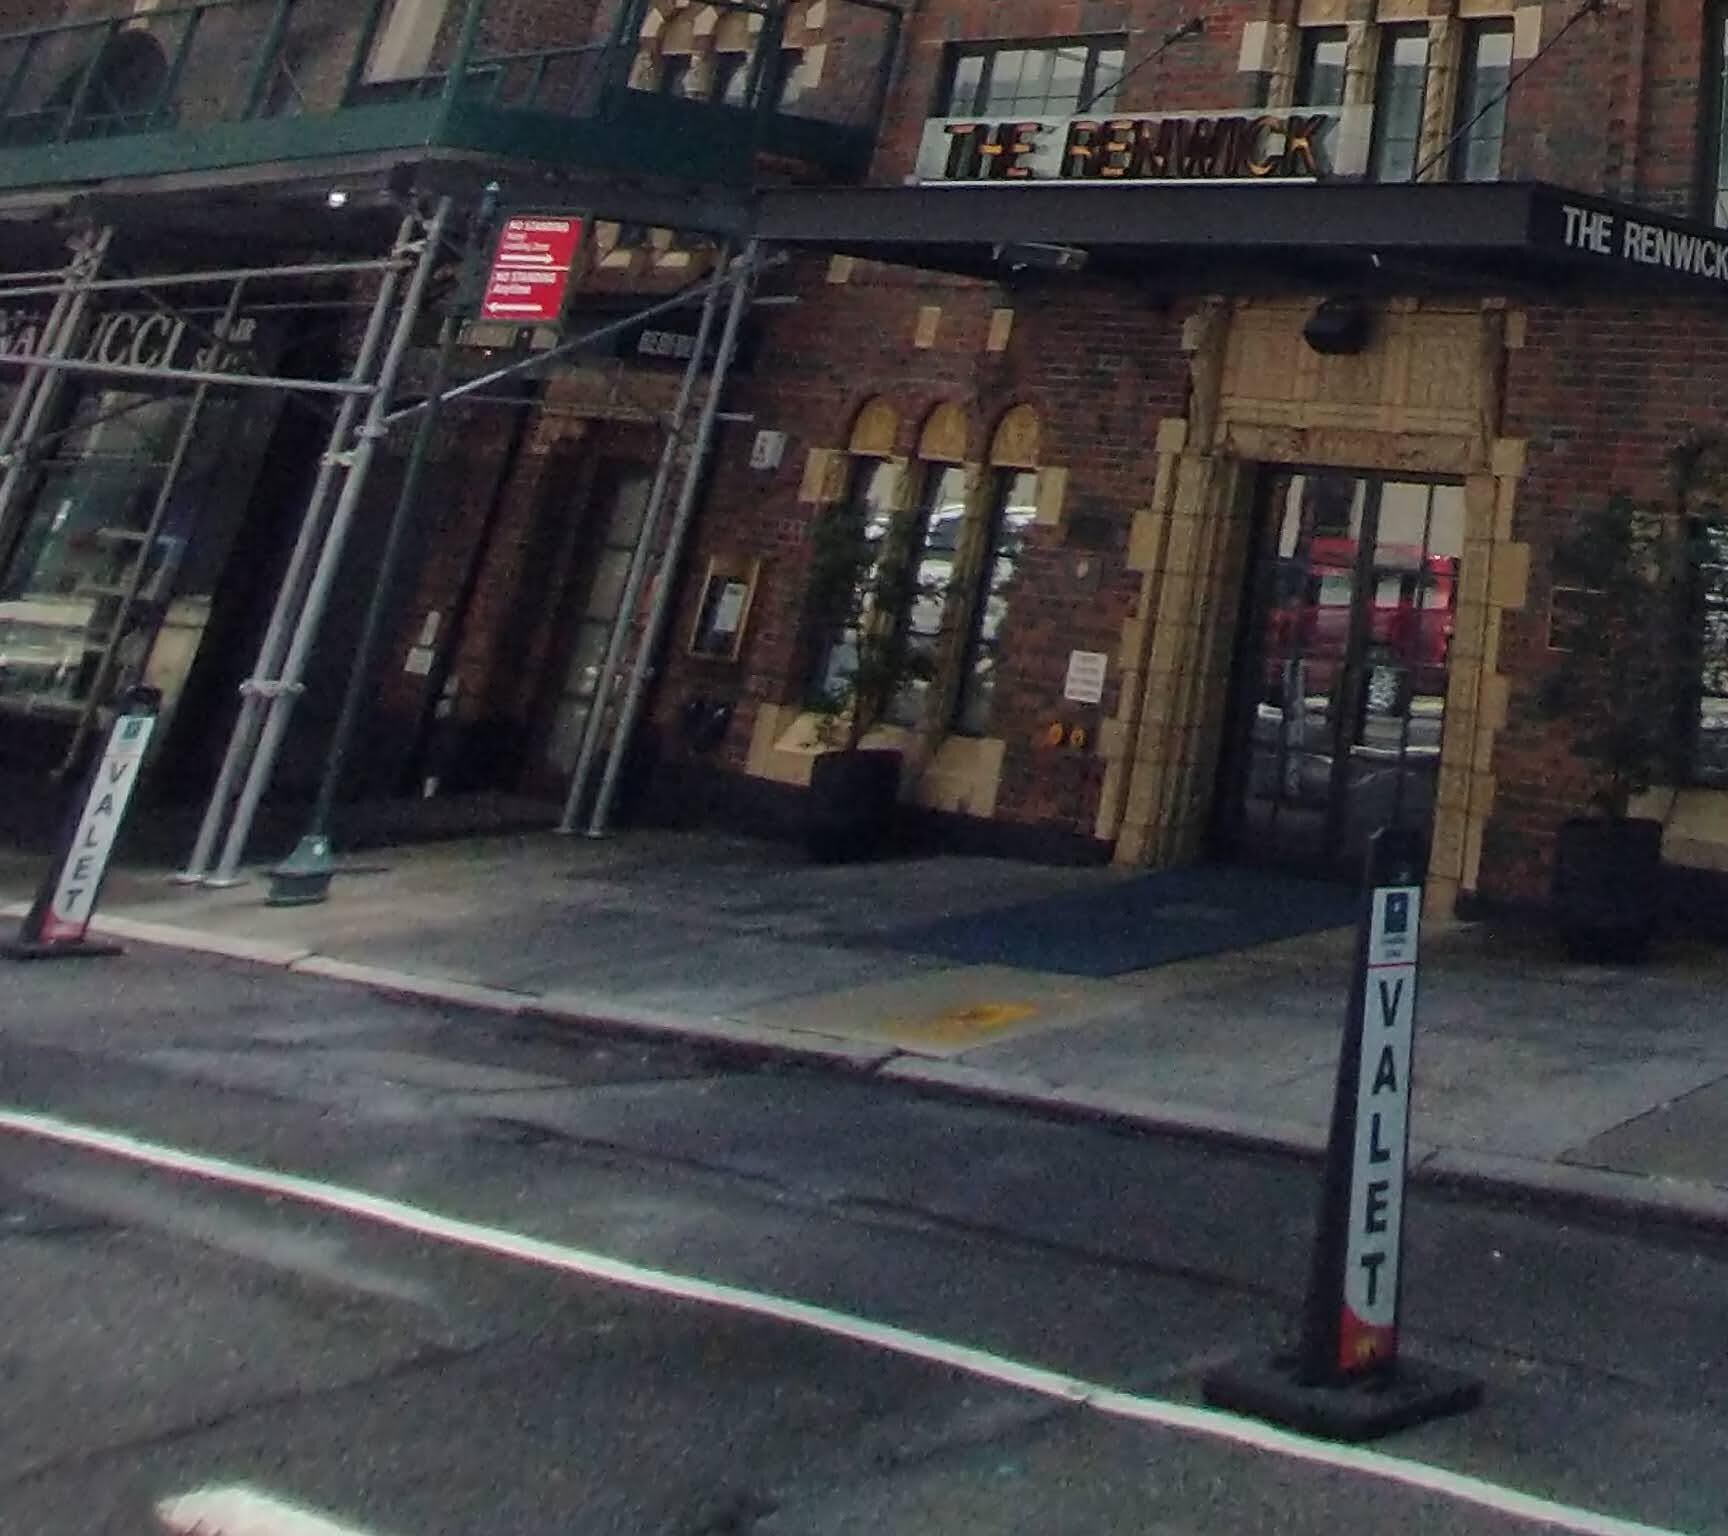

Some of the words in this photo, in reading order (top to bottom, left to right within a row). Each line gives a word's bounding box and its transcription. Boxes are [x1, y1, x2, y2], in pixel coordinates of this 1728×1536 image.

[944, 122, 1041, 179] THE
[1060, 113, 1337, 179] RENWICK
[1562, 204, 1614, 255] THE
[64, 761, 128, 913] VALET
[1361, 979, 1403, 1307] VALET
